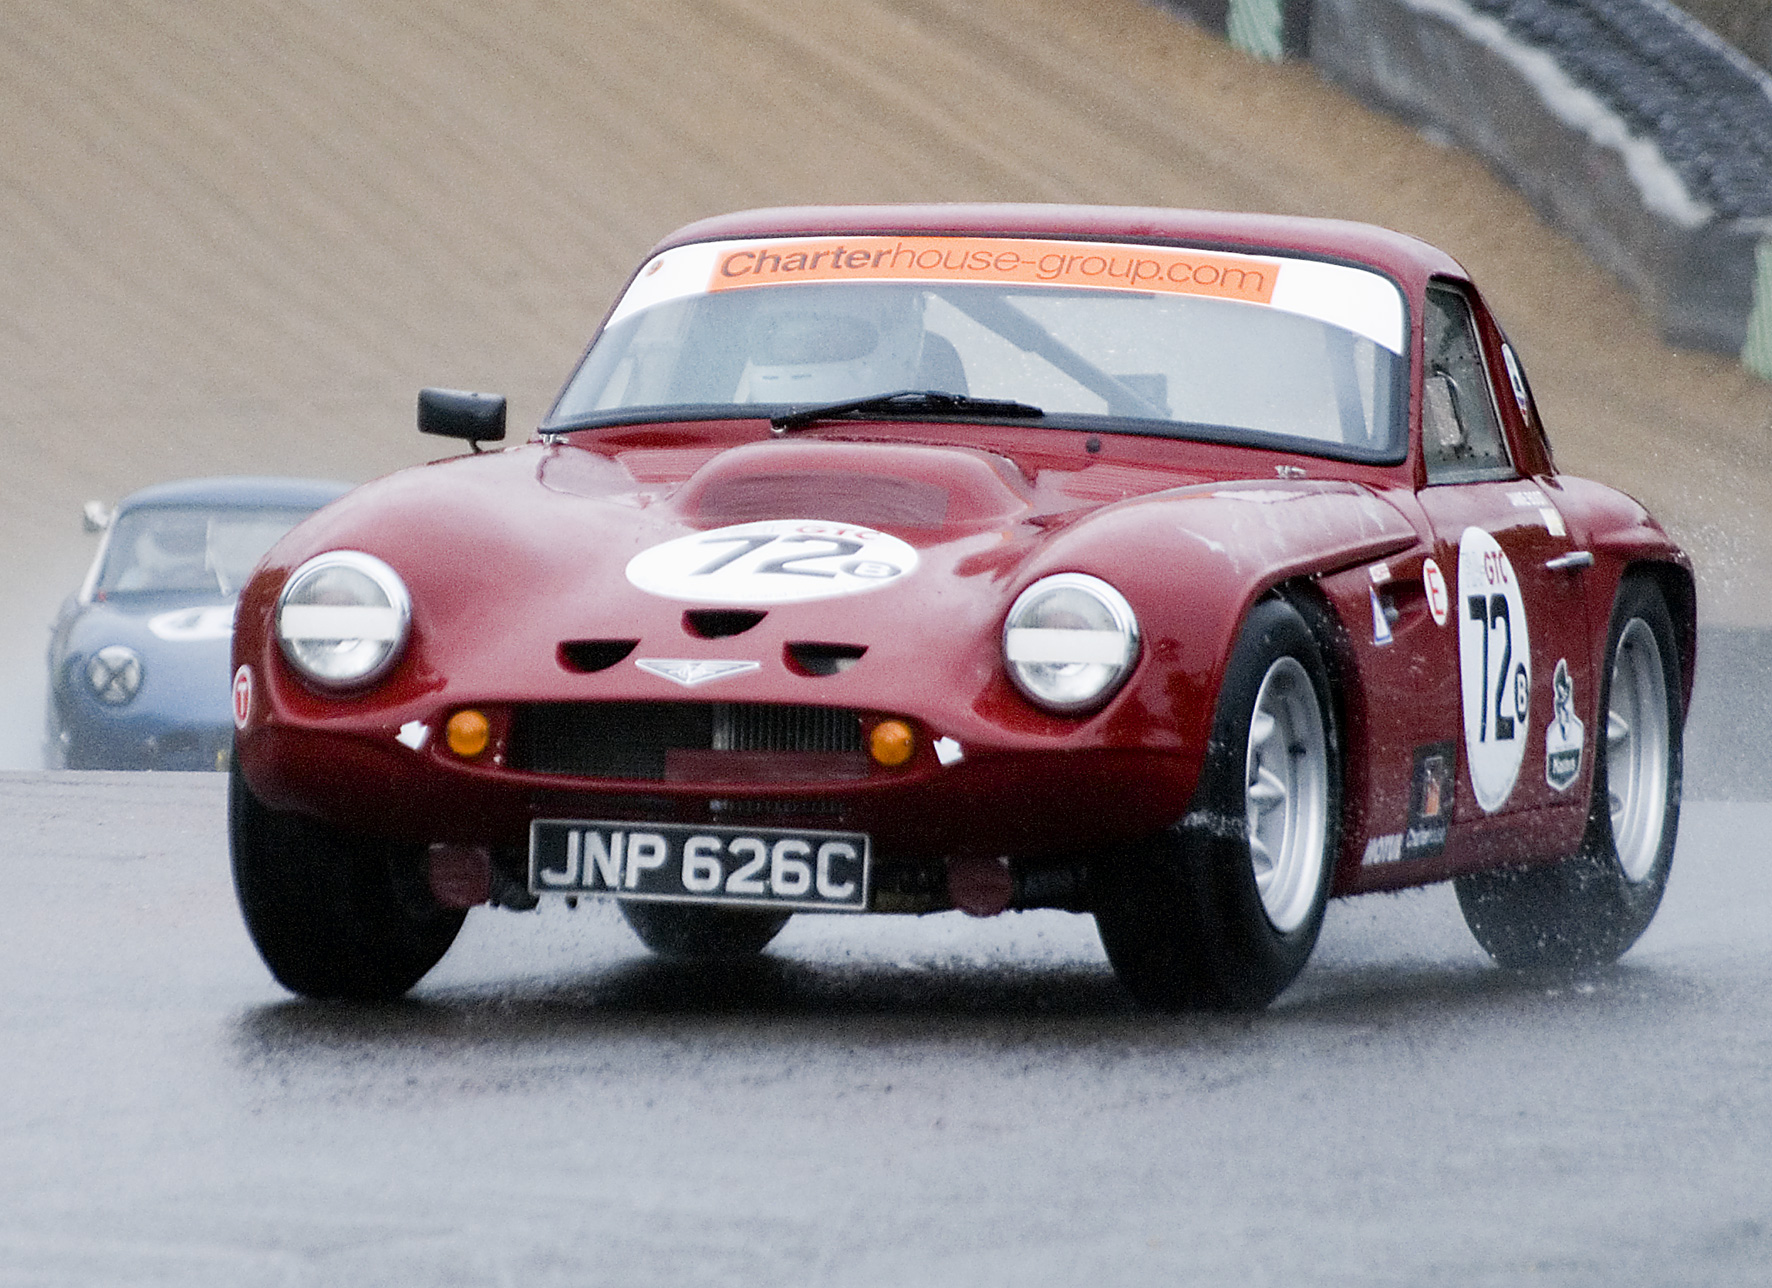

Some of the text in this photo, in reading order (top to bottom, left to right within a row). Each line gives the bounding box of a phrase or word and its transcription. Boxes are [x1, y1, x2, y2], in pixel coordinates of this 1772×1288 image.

[721, 242, 1265, 292] Charterhouse-group.com
[795, 524, 881, 540] GTC
[689, 534, 864, 579] 72
[1484, 551, 1508, 585] GTC
[1427, 567, 1445, 615] E
[1468, 593, 1515, 742] 72
[541, 831, 856, 898] JNP 626C
